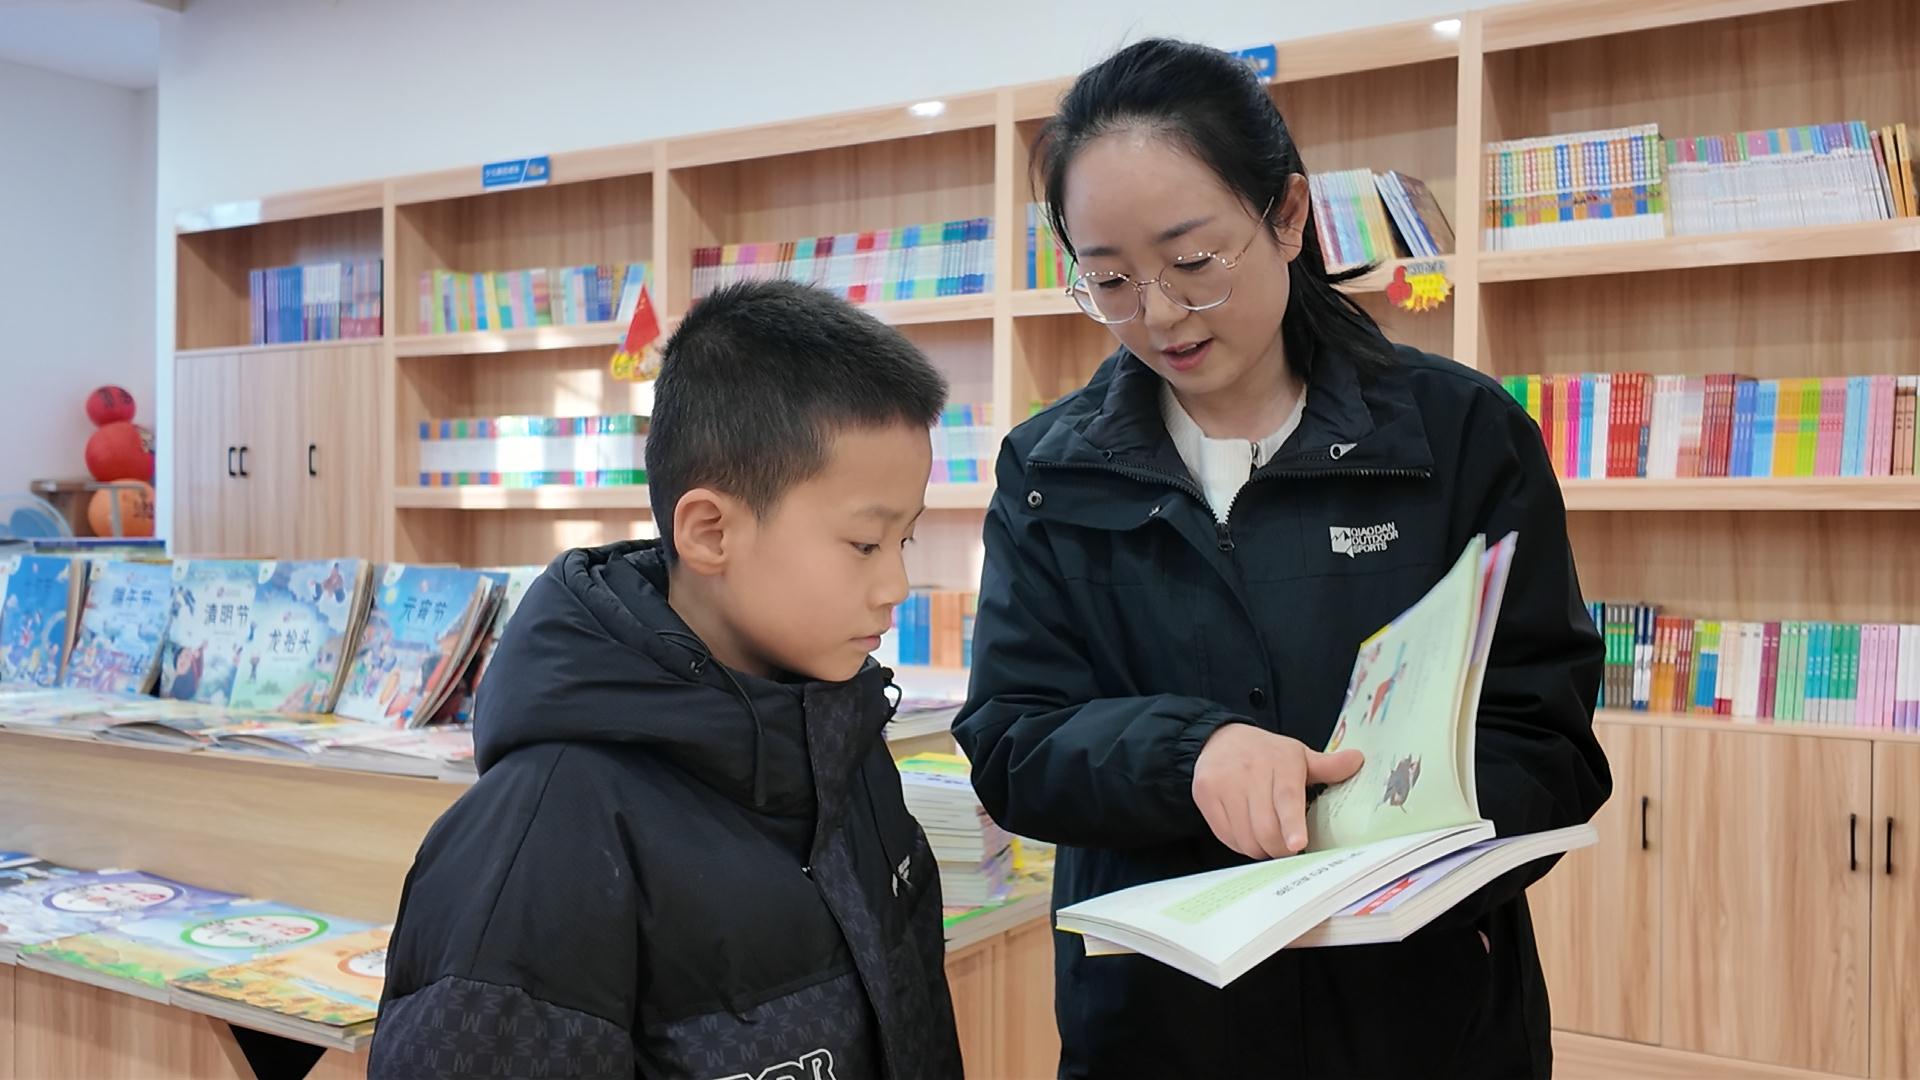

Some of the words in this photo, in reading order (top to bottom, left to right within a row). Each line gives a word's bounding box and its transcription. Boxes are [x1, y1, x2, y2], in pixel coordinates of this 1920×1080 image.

[1352, 530, 1399, 545] OUTDOOR
[1353, 542, 1388, 553] SPORTS
[203, 602, 250, 627] 清明节
[398, 596, 448, 625] 元宵节
[265, 628, 312, 653] 龙抬头
